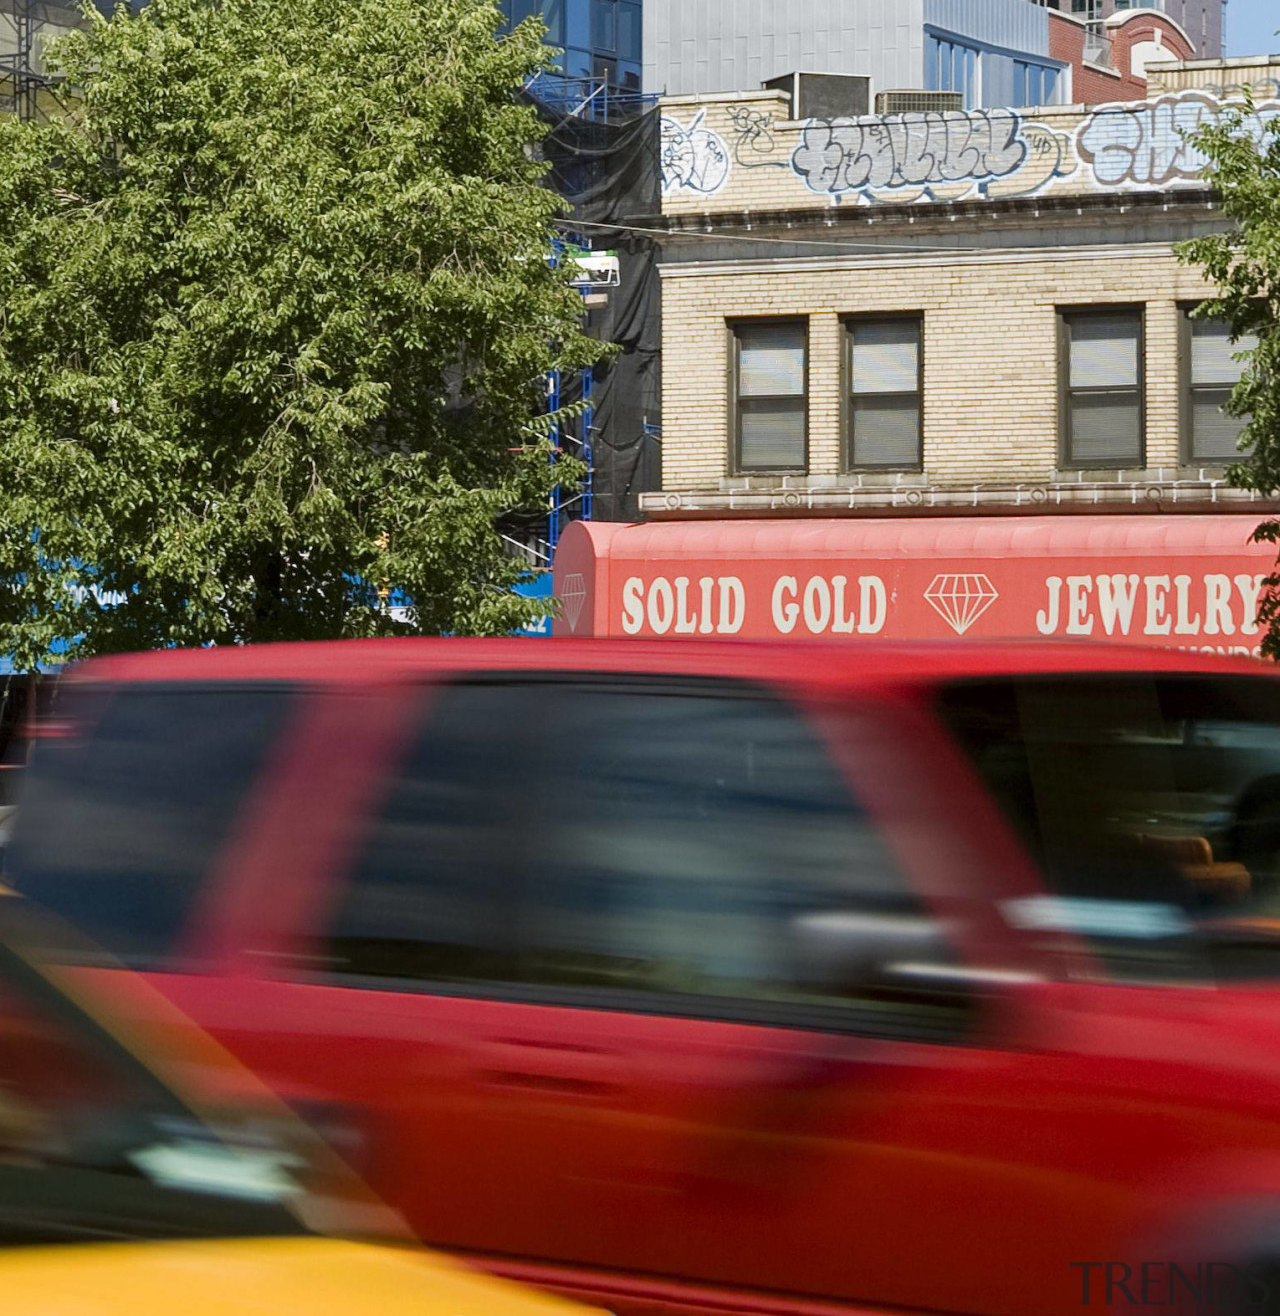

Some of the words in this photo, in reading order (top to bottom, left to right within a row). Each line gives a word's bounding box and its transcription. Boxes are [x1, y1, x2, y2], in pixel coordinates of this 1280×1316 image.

[622, 576, 745, 634] SOLID
[772, 575, 887, 634] GOLD
[1036, 573, 1269, 636] JEWELRY
